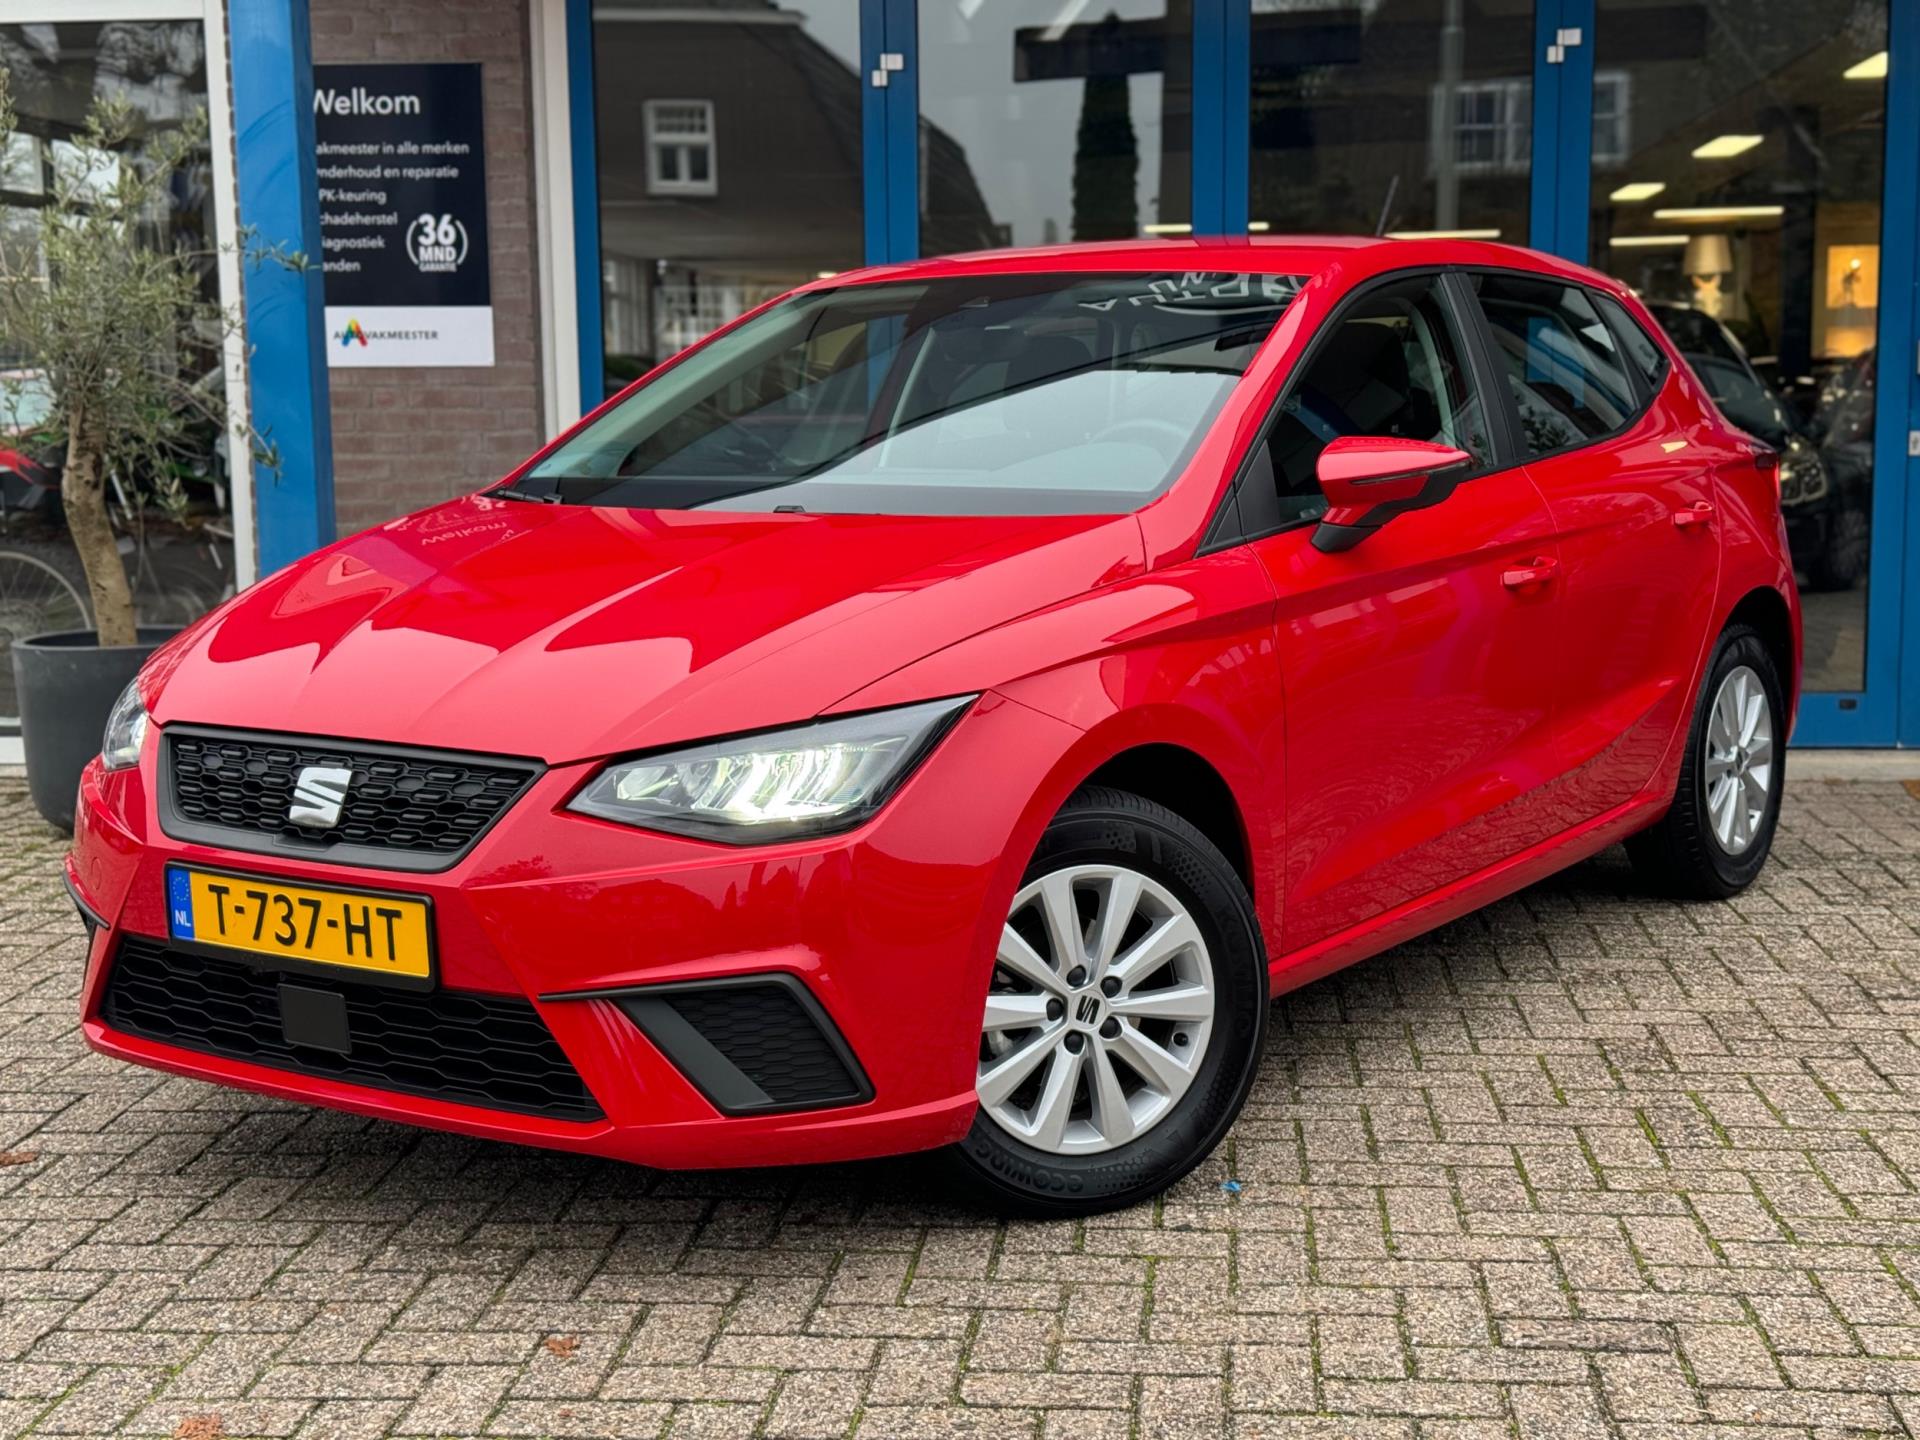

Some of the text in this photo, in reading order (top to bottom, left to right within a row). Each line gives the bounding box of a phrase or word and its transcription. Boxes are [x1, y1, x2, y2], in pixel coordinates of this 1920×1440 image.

[313, 87, 421, 115] Welkom
[316, 140, 470, 155] akmeester in alle merken
[316, 165, 459, 181] nderhoud en reparatie
[318, 188, 388, 205] PK-keuring
[320, 211, 398, 226] chadeherstel
[417, 213, 457, 246] 36
[321, 235, 386, 252] iagnostiek
[418, 246, 458, 262] MND
[322, 258, 362, 272] anden
[333, 330, 439, 341] AVAKMEESTER
[175, 909, 192, 928] NL
[208, 884, 402, 961] T-737-HT
